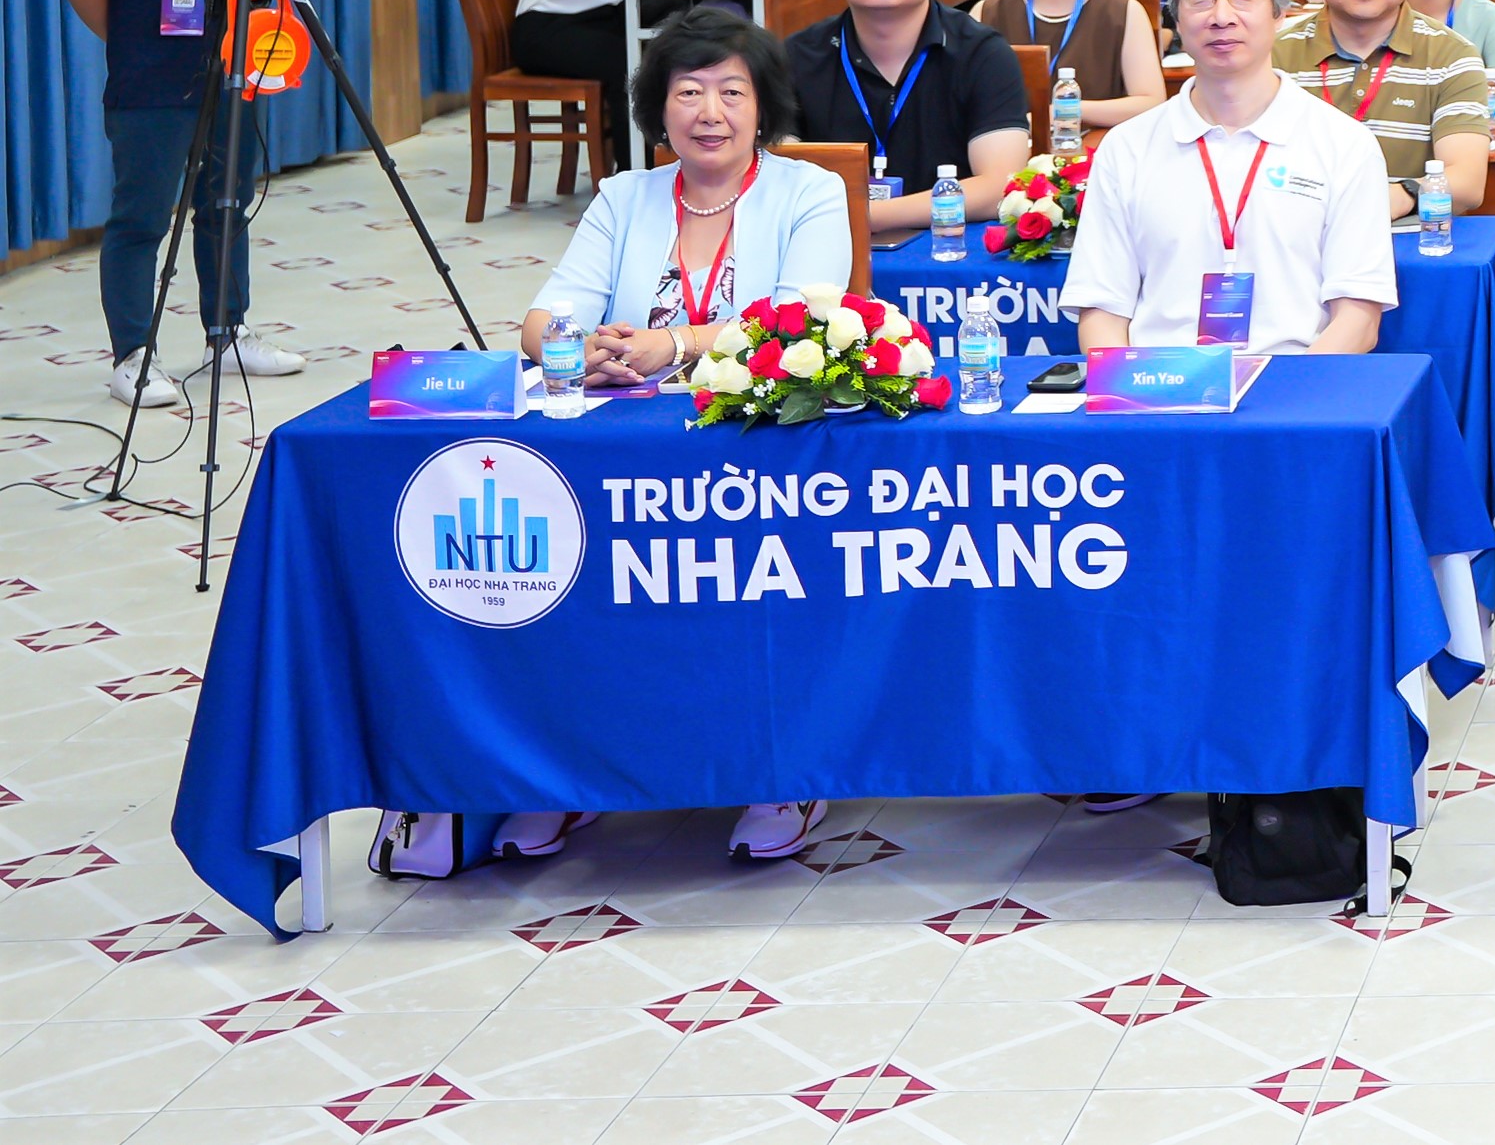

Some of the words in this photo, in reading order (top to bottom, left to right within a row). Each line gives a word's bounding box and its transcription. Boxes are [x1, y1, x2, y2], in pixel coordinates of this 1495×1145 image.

[900, 276, 1081, 325] TRƯỜN
[423, 377, 443, 390] Jie
[448, 378, 464, 390] Lu
[1133, 372, 1155, 384] Xin
[1158, 372, 1184, 384] Yao
[603, 463, 849, 522] TRƯỜNG
[869, 465, 969, 521] ĐẠI
[992, 464, 1124, 520] HỌC
[445, 534, 538, 573] NTU
[612, 535, 806, 603] NHA
[832, 523, 1127, 596] TRANG
[428, 578, 452, 591] ĐẠI
[455, 578, 481, 592] HỌC
[484, 579, 510, 591] NHA
[512, 580, 557, 591] TRANG
[482, 596, 506, 607] 1959
